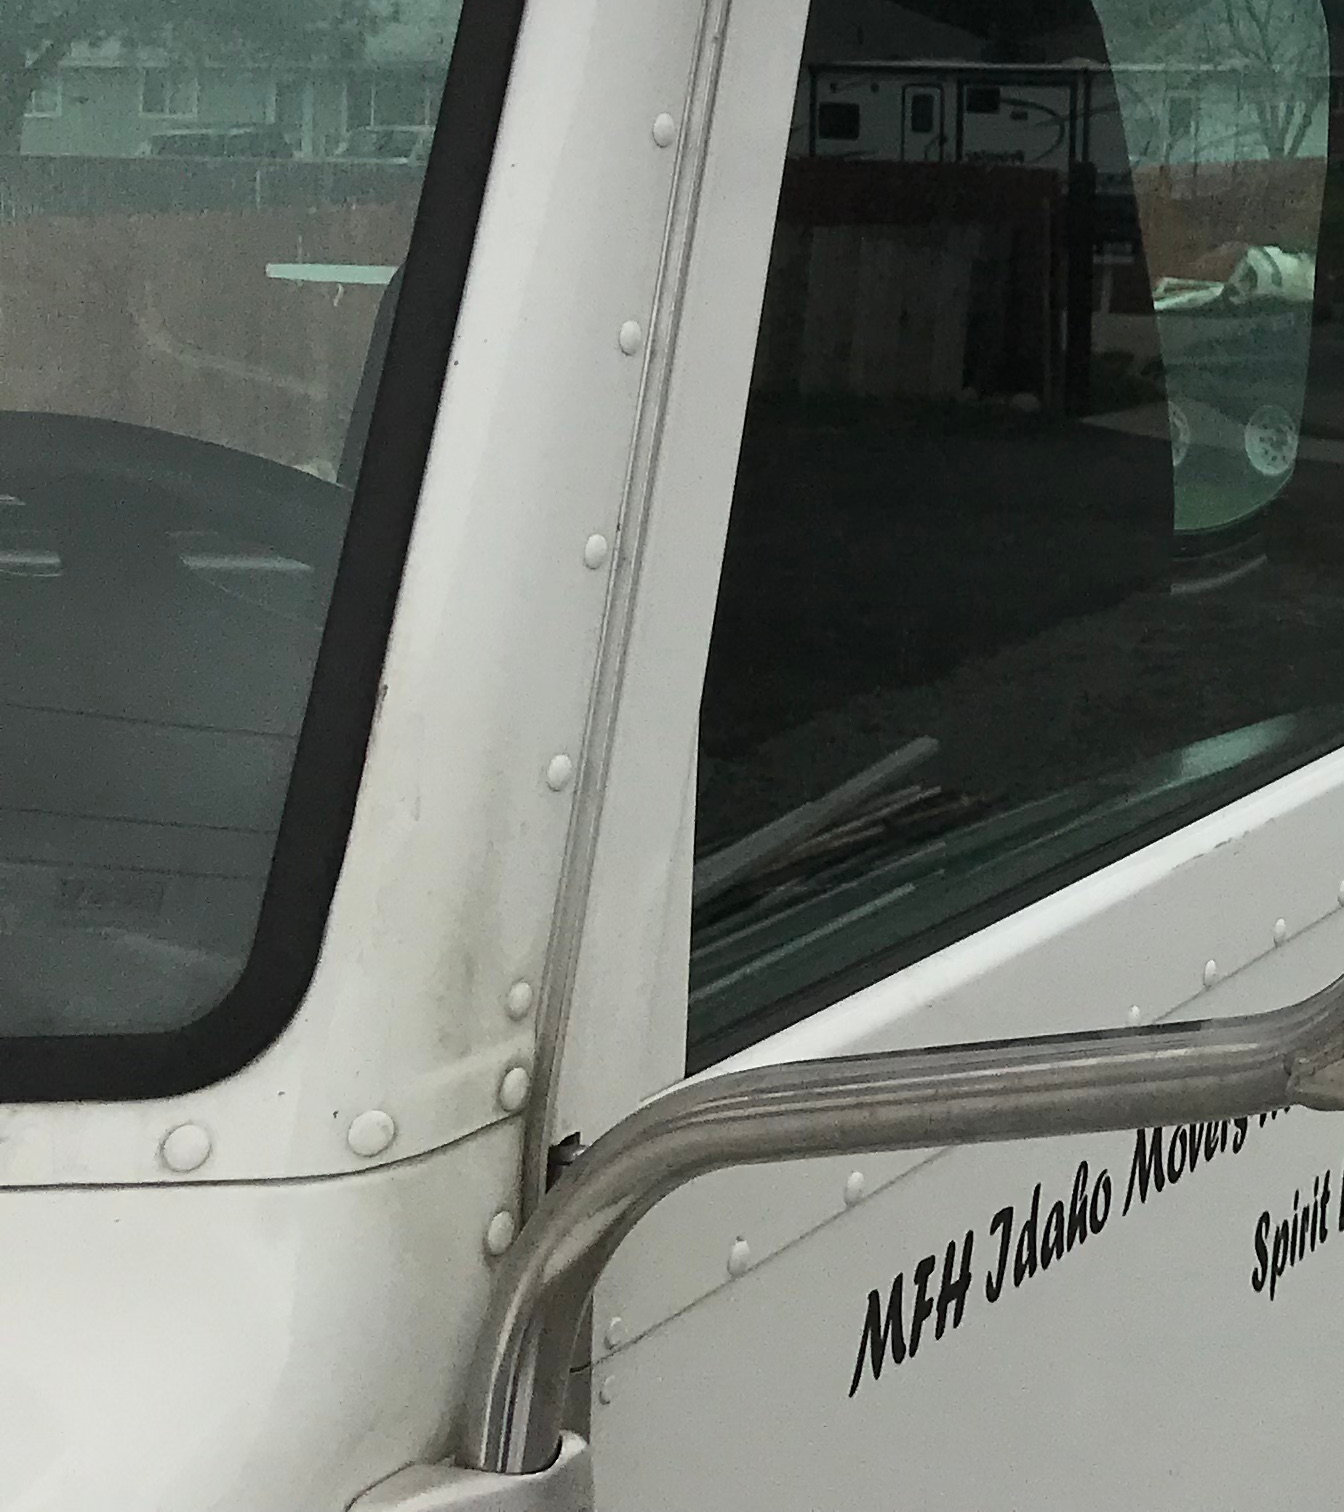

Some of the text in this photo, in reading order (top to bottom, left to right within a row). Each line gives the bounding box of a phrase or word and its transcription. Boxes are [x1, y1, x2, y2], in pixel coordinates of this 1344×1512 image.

[849, 1230, 973, 1398] MFH
[986, 1160, 1112, 1303] Idaho
[1251, 1169, 1331, 1302] Spirit
